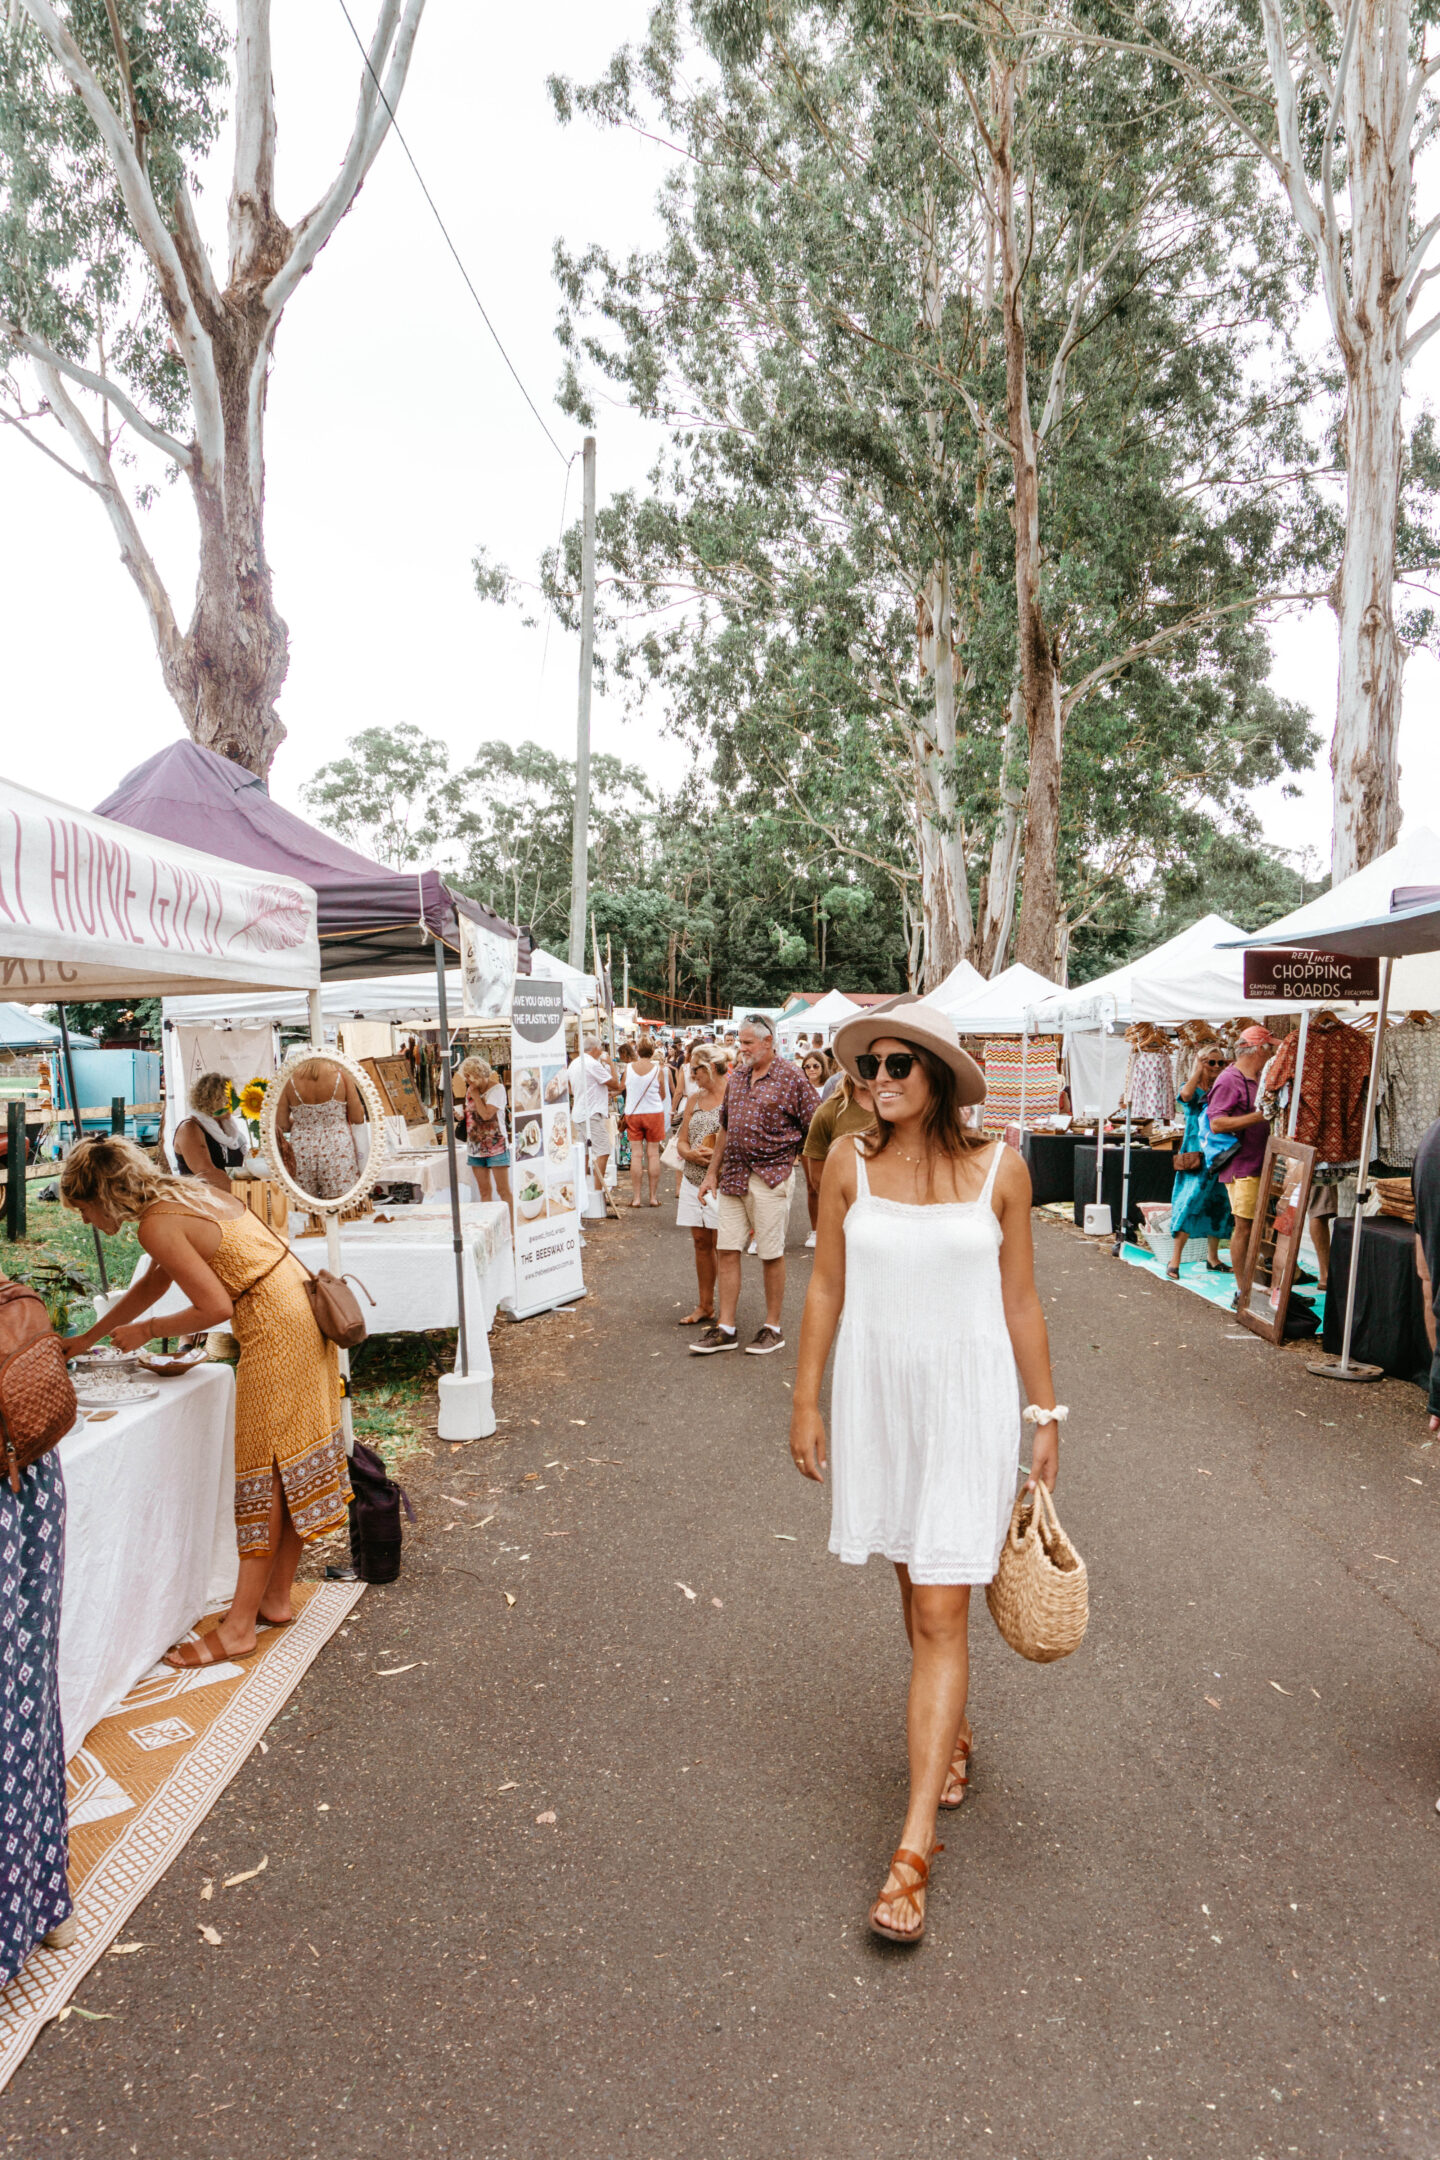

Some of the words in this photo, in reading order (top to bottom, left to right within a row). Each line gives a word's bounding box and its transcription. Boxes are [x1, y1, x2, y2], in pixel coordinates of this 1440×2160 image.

[45, 815, 145, 945] HOME
[149, 855, 224, 957] GYPSY
[1272, 964, 1352, 980] CHOPPING
[1283, 983, 1341, 998] BOARDS
[512, 995, 525, 1007] AVE
[525, 995, 537, 1007] YOU
[537, 996, 553, 1007] GIVEN
[553, 996, 561, 1007] UP
[513, 1013, 525, 1025] THE
[525, 1013, 547, 1025] PLASTIC
[548, 1013, 560, 1025] YET?
[520, 1252, 533, 1265] THE
[535, 1242, 565, 1261] BEESWAX
[566, 1239, 575, 1250] CO
